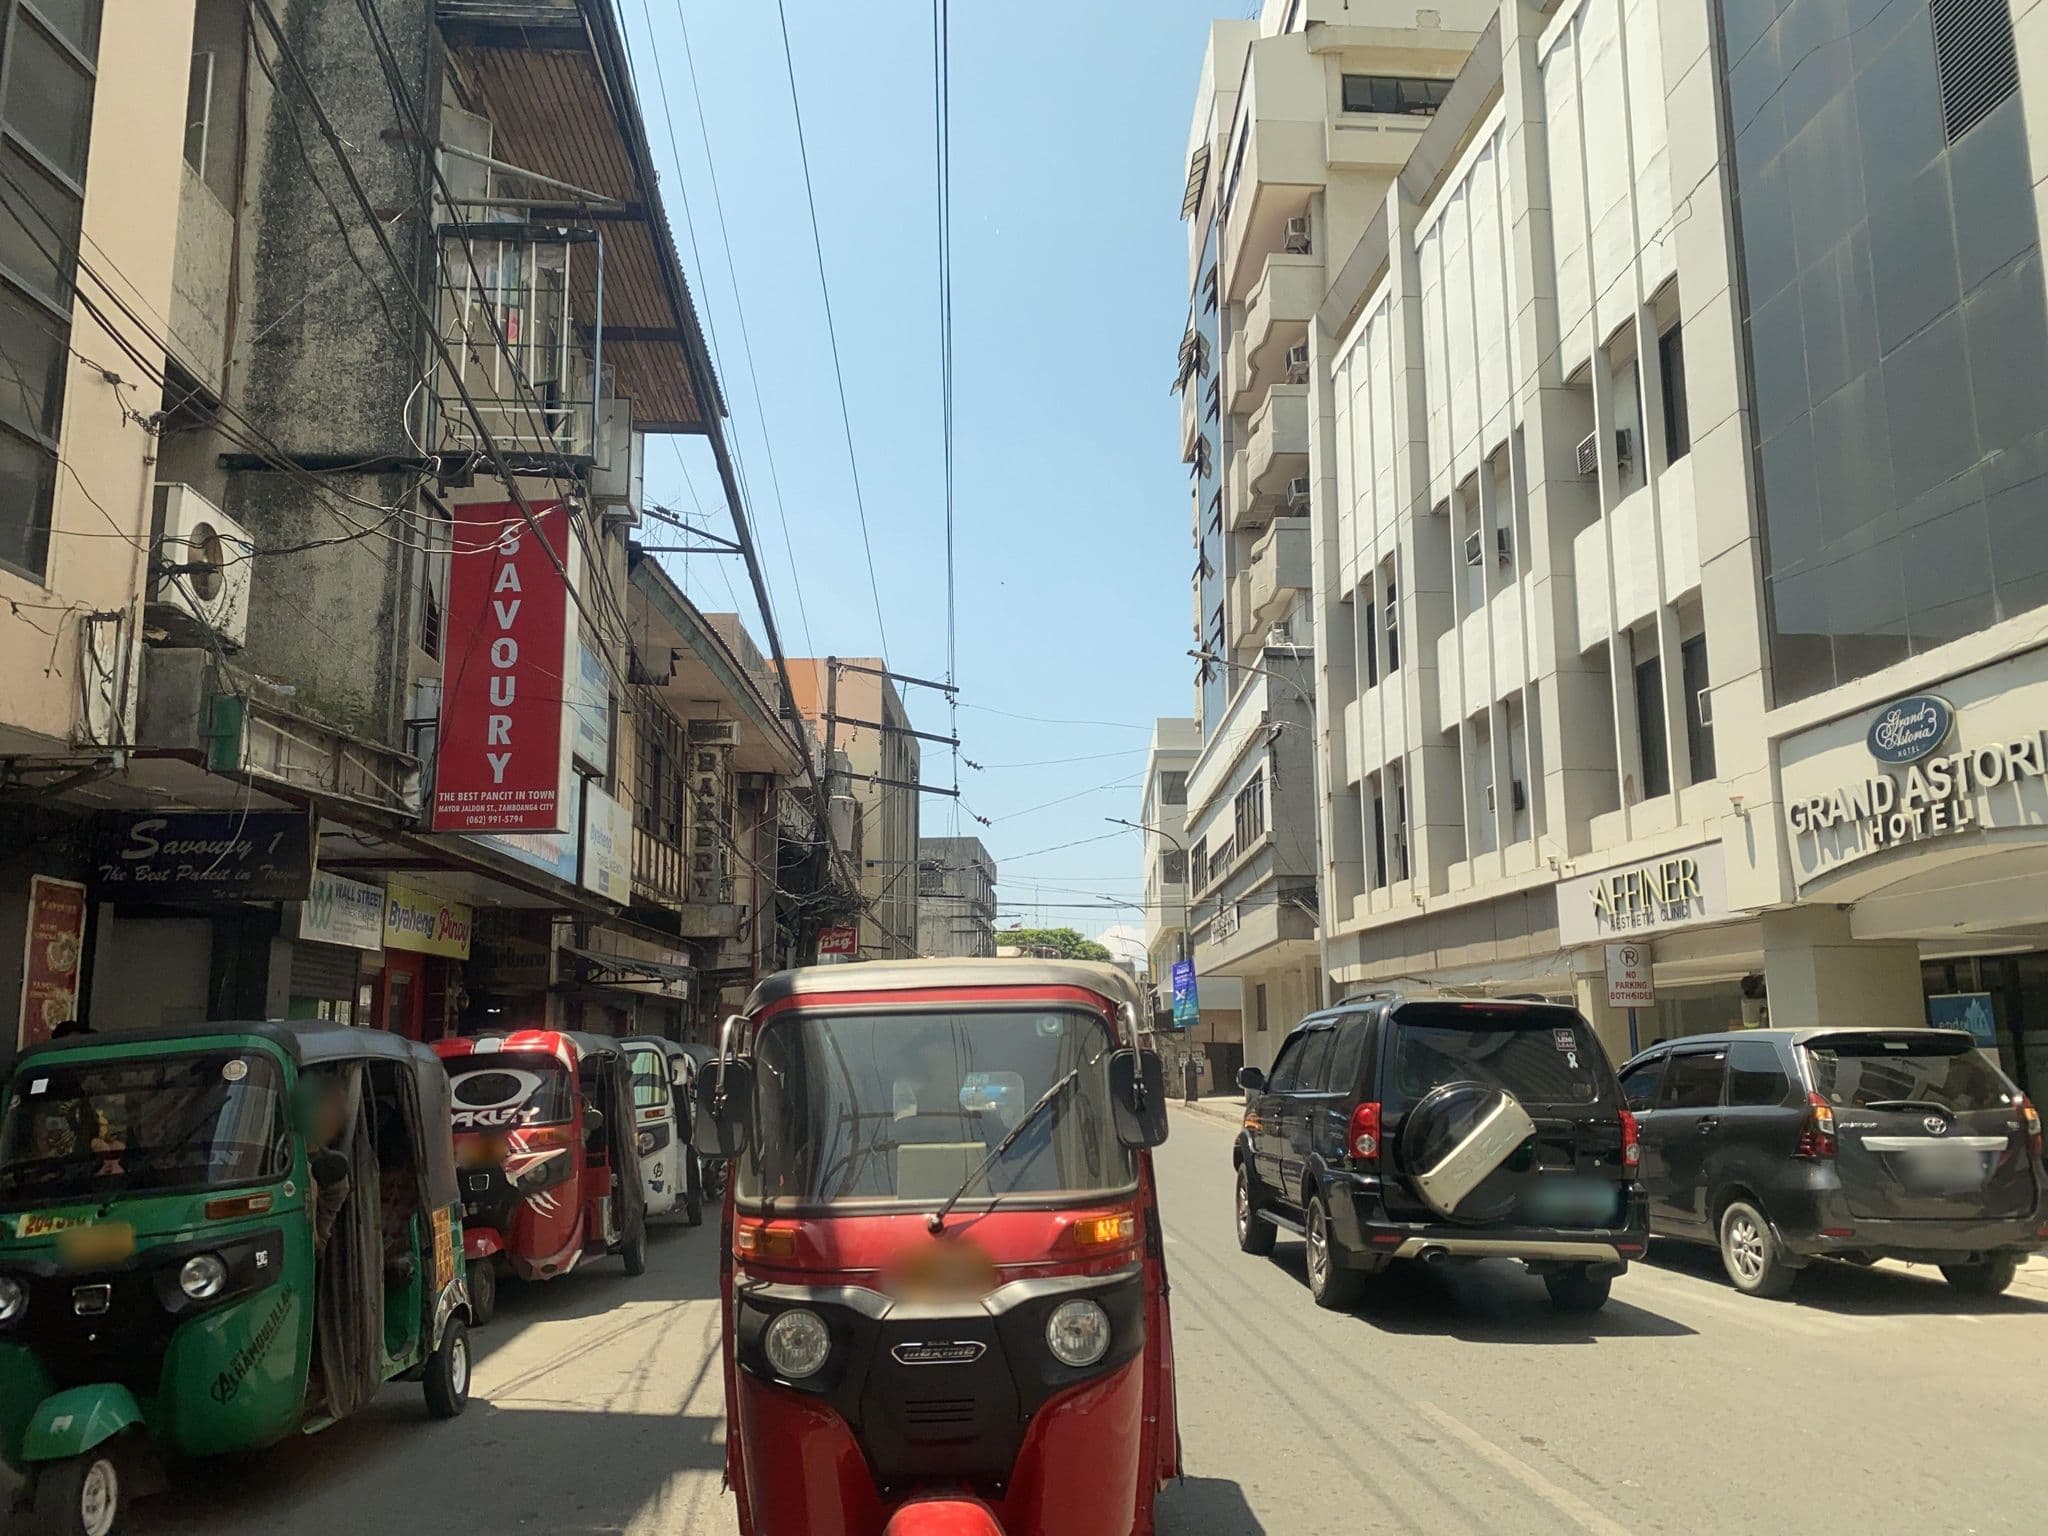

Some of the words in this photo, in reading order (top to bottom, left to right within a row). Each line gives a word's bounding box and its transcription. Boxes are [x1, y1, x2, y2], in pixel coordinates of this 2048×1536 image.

[486, 524, 522, 784] SAVOURY
[1887, 701, 1936, 729] Grand
[1877, 725, 1933, 750] Astoria
[1897, 745, 1921, 757] HOTEL
[1790, 774, 1896, 835] GRAND
[1902, 728, 2047, 807] ASTORI
[438, 805, 460, 813] MAYOR
[498, 804, 538, 812] ZAMBOANGA
[539, 803, 554, 811] CITY
[439, 792, 455, 802] THE
[458, 791, 478, 801] BEST
[480, 791, 513, 801] PANCIT
[515, 791, 526, 800] IN
[528, 790, 555, 800] TOWN
[466, 815, 486, 825] (062)
[488, 815, 524, 824] 991-5794
[693, 751, 717, 898] BAKERY
[1869, 798, 1974, 842] HOTEL
[121, 818, 254, 861] Savoury
[268, 831, 285, 855] 1
[98, 864, 128, 882] The
[134, 864, 170, 882] Best
[234, 868, 250, 881] in
[1589, 856, 1704, 915] AFFINER
[335, 883, 355, 902] WALL
[357, 888, 383, 908] STREET
[388, 900, 436, 939] Byaheng
[437, 906, 470, 952] Pinoy
[1610, 911, 1655, 931] AESTHETIC
[1614, 981, 1648, 990] PARKING
[1625, 971, 1637, 979] NO
[451, 1107, 541, 1128] AKLEY
